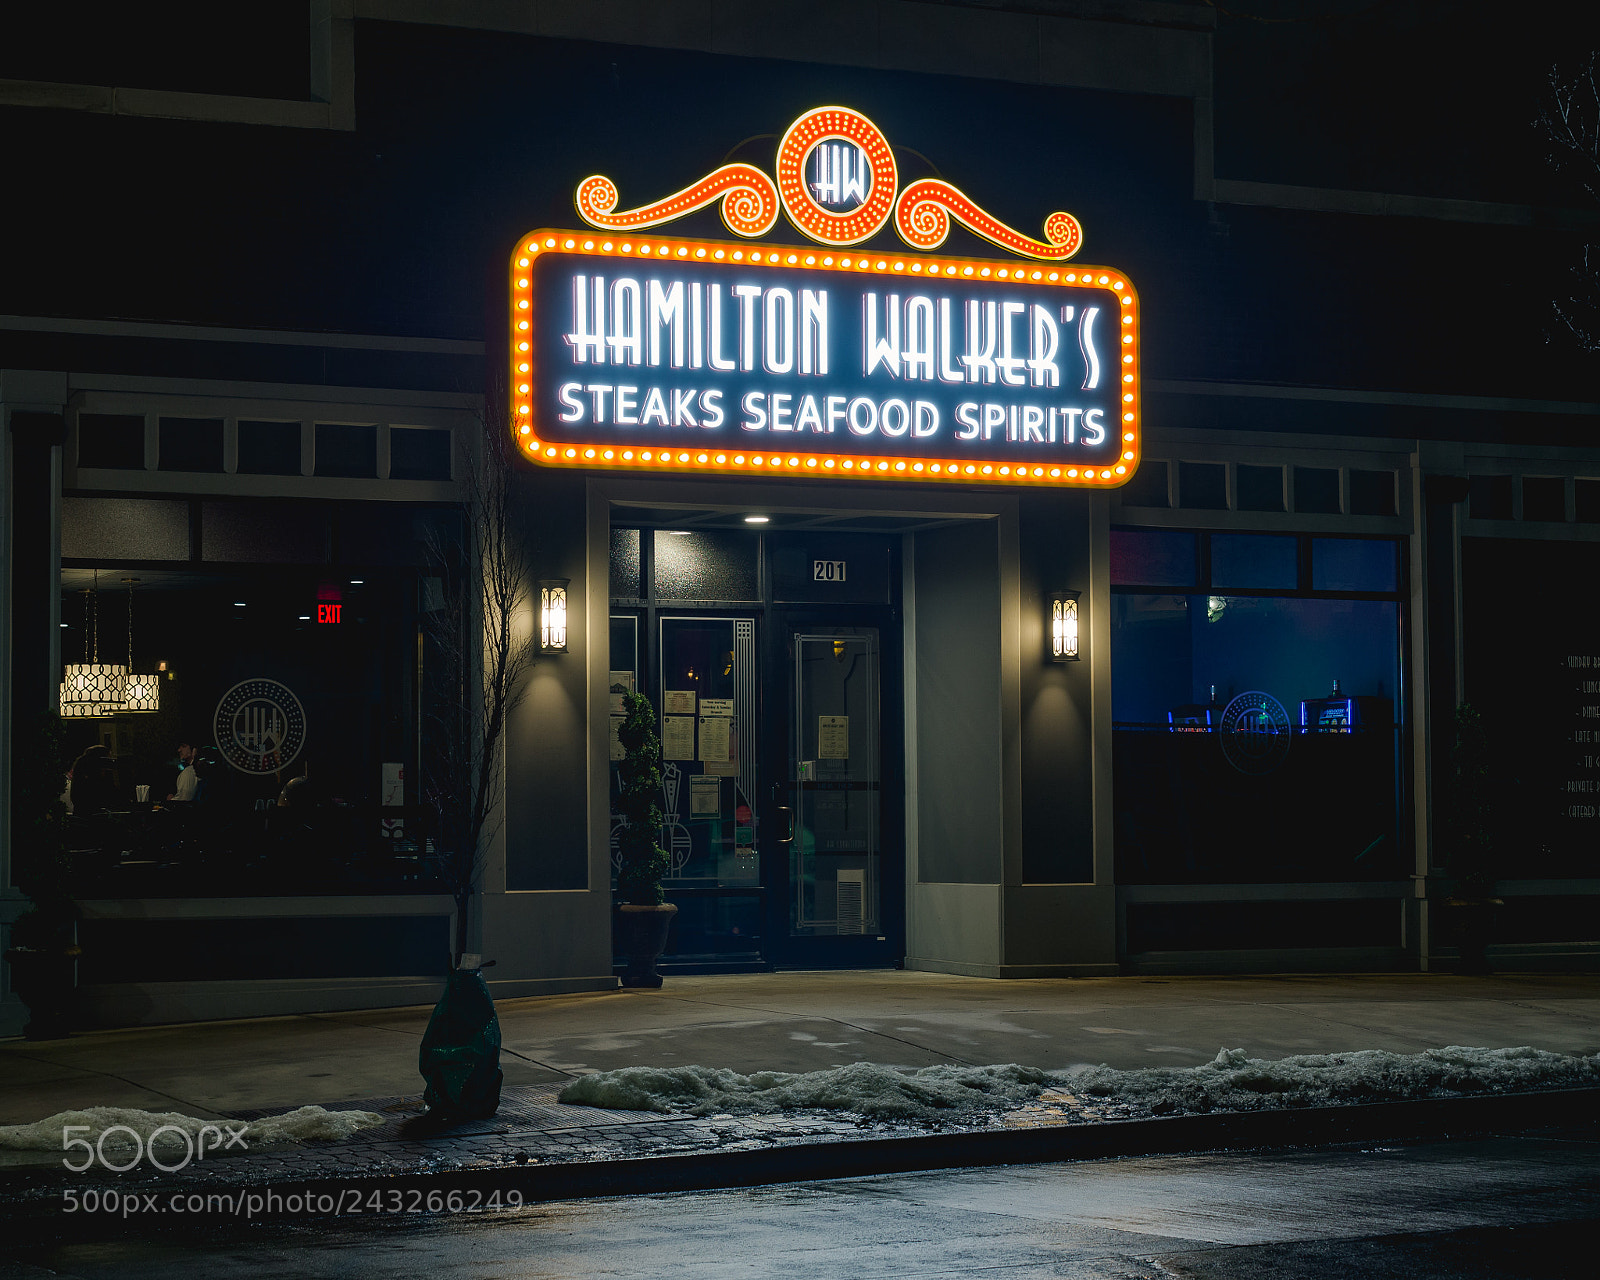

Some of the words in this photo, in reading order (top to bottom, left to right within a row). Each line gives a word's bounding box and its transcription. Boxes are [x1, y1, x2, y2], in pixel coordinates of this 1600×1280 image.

[811, 144, 865, 205] HW
[563, 274, 829, 376] HAMILTON
[862, 292, 1101, 390] WALKER'S
[558, 382, 725, 429] STEAKS
[741, 391, 940, 439] SEAFOOD
[954, 402, 1106, 446] SPIRITS
[815, 561, 844, 581] 201
[317, 604, 343, 624] EXIT
[1567, 655, 1591, 669] SUNDAY
[1575, 730, 1591, 743] LATE
[1567, 780, 1594, 793] PRIVATE
[1568, 805, 1596, 818] CATERED
